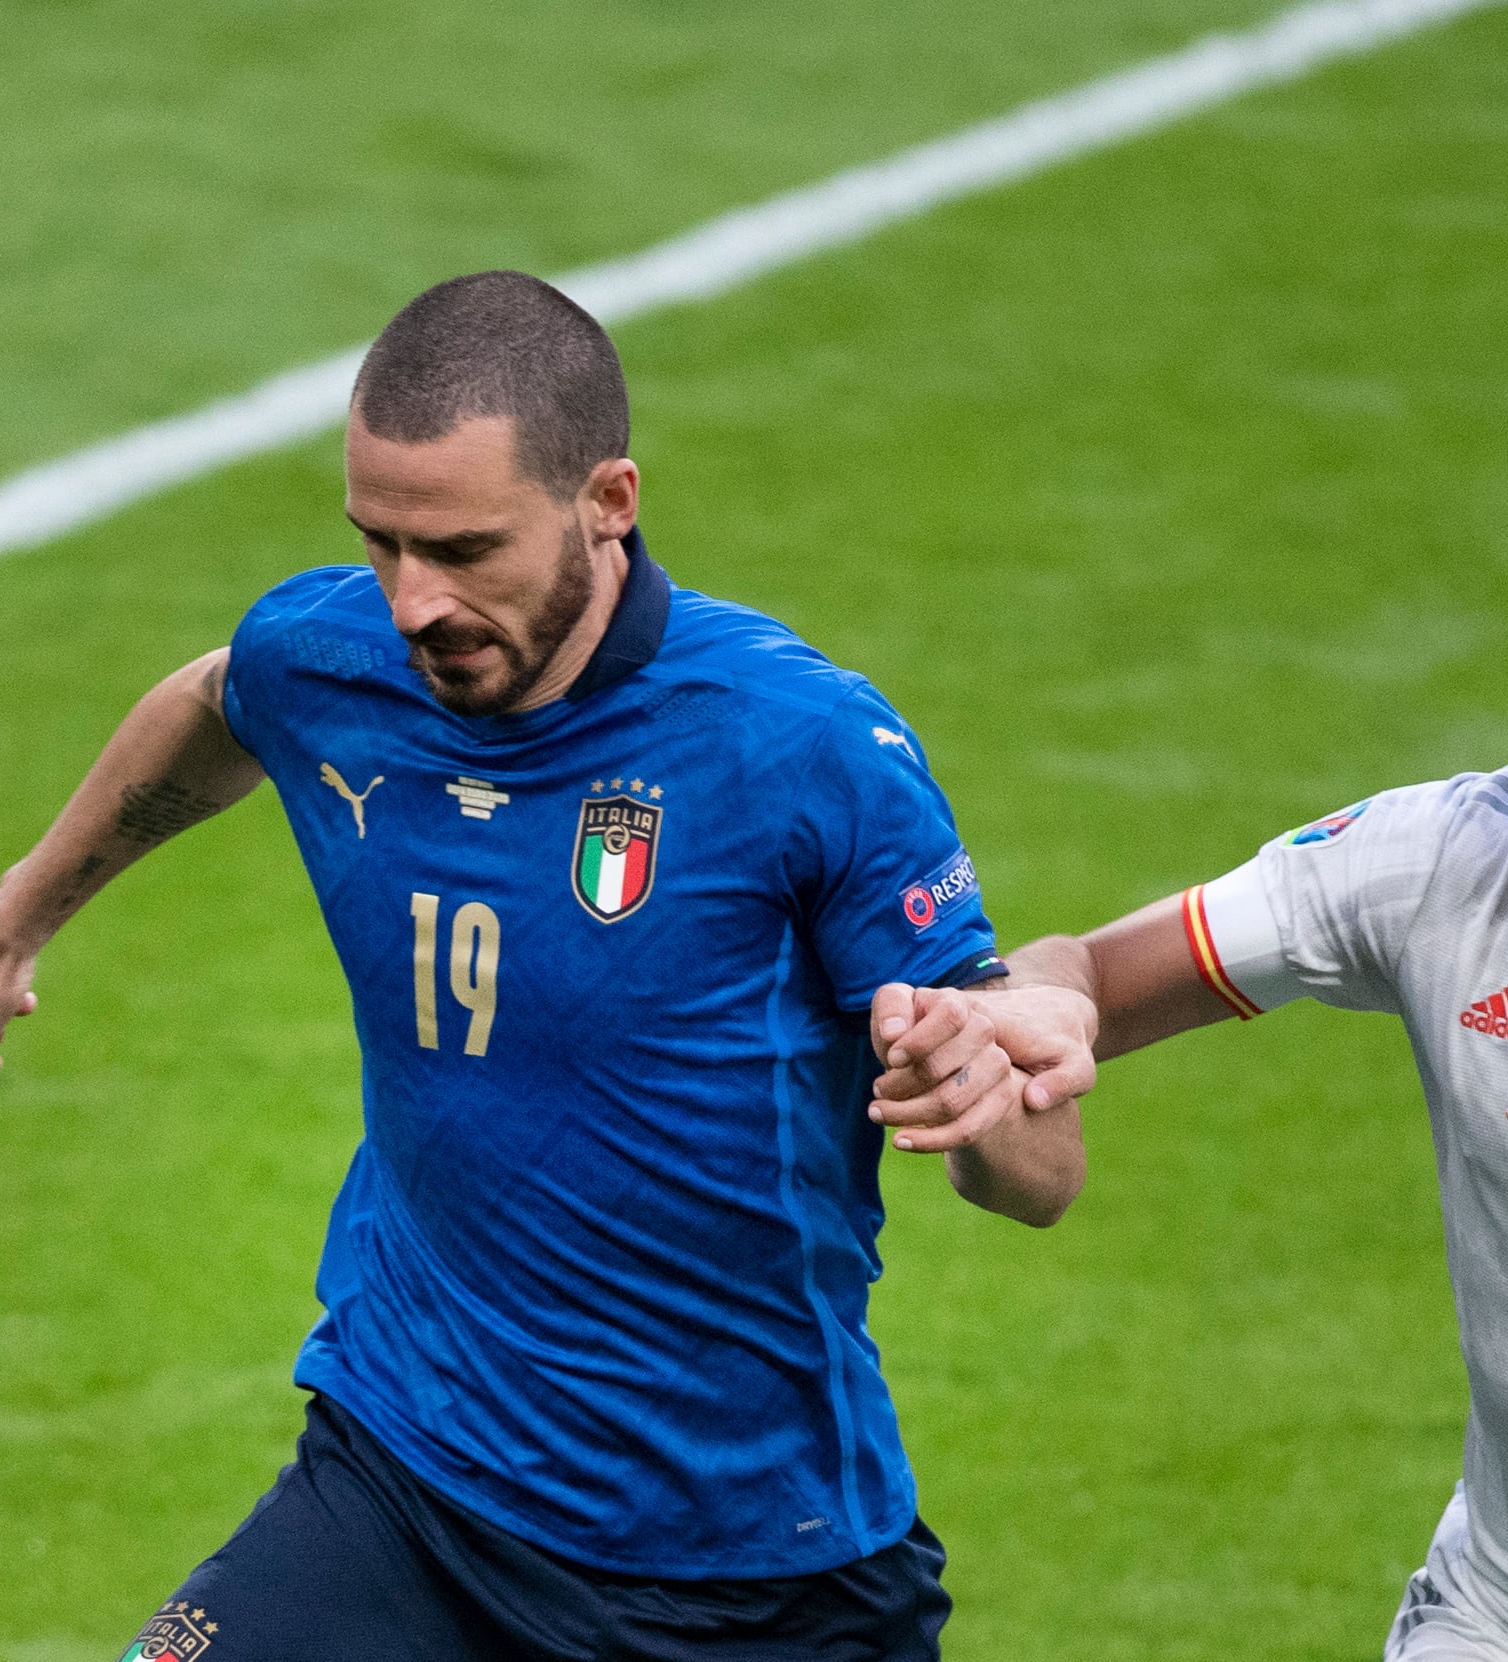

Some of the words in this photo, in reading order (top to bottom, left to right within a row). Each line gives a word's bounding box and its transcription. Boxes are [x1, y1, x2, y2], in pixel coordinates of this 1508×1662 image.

[588, 808, 653, 830] ITALIA
[410, 892, 501, 1057] 19
[144, 1621, 197, 1653] ITALIA
